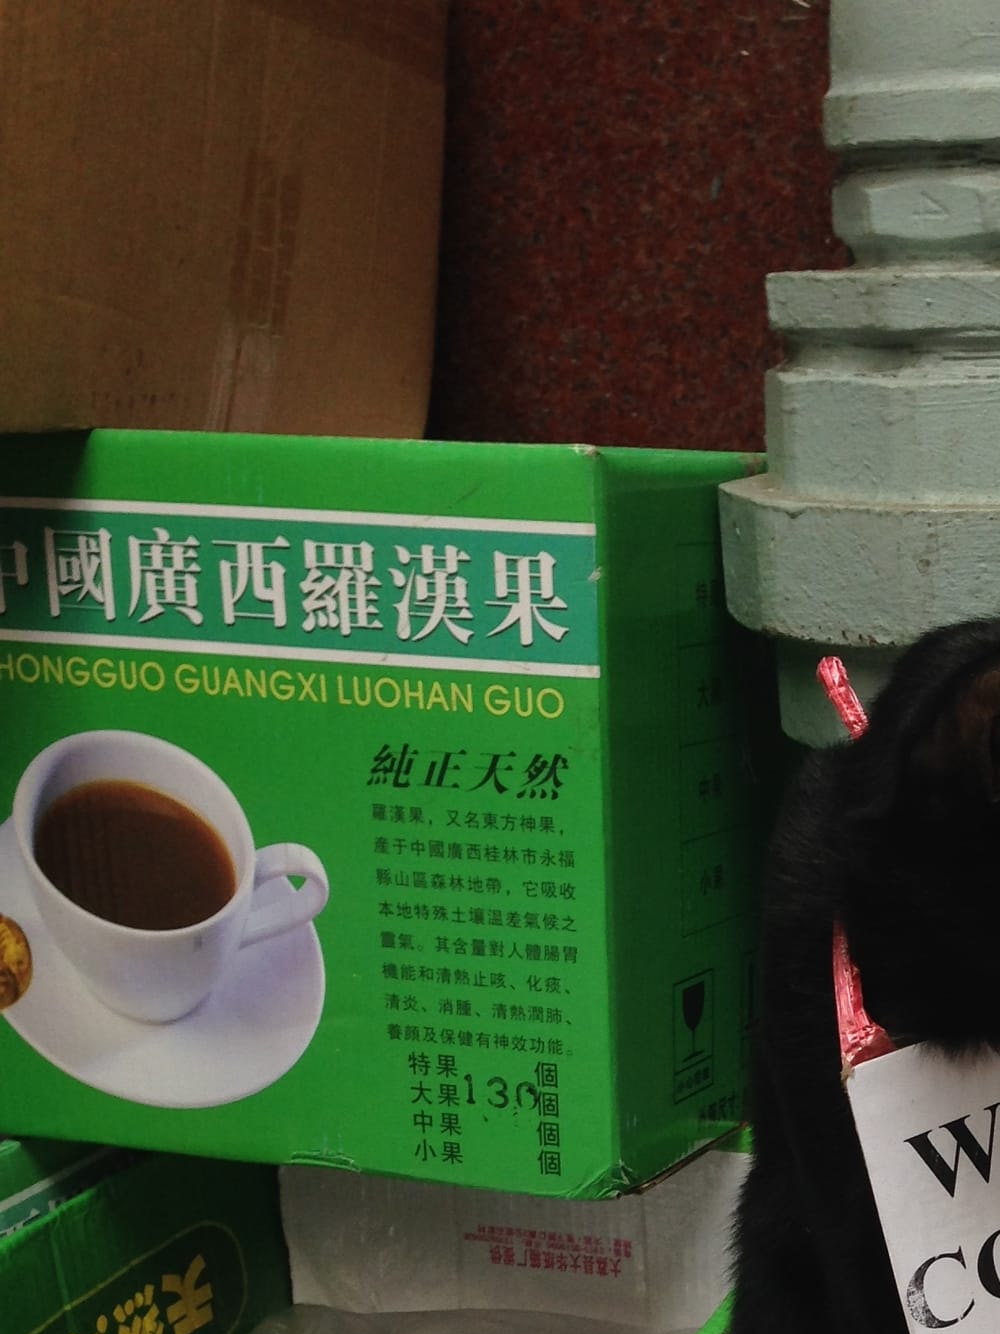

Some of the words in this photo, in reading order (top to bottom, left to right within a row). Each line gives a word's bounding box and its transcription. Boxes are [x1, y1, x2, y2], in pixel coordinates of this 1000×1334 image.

[174, 663, 328, 703] GUANGXI
[336, 675, 473, 712] LUOHAN
[484, 685, 565, 719] GUO
[366, 743, 569, 801] 純正天然
[408, 1051, 459, 1079] 特果
[534, 1061, 559, 1089] 個
[410, 1081, 460, 1108] 大果
[536, 1091, 560, 1119] 個
[413, 1109, 463, 1137] 中果
[536, 1121, 561, 1148] 個
[415, 1138, 464, 1166] 小果
[537, 1149, 562, 1177] 個
